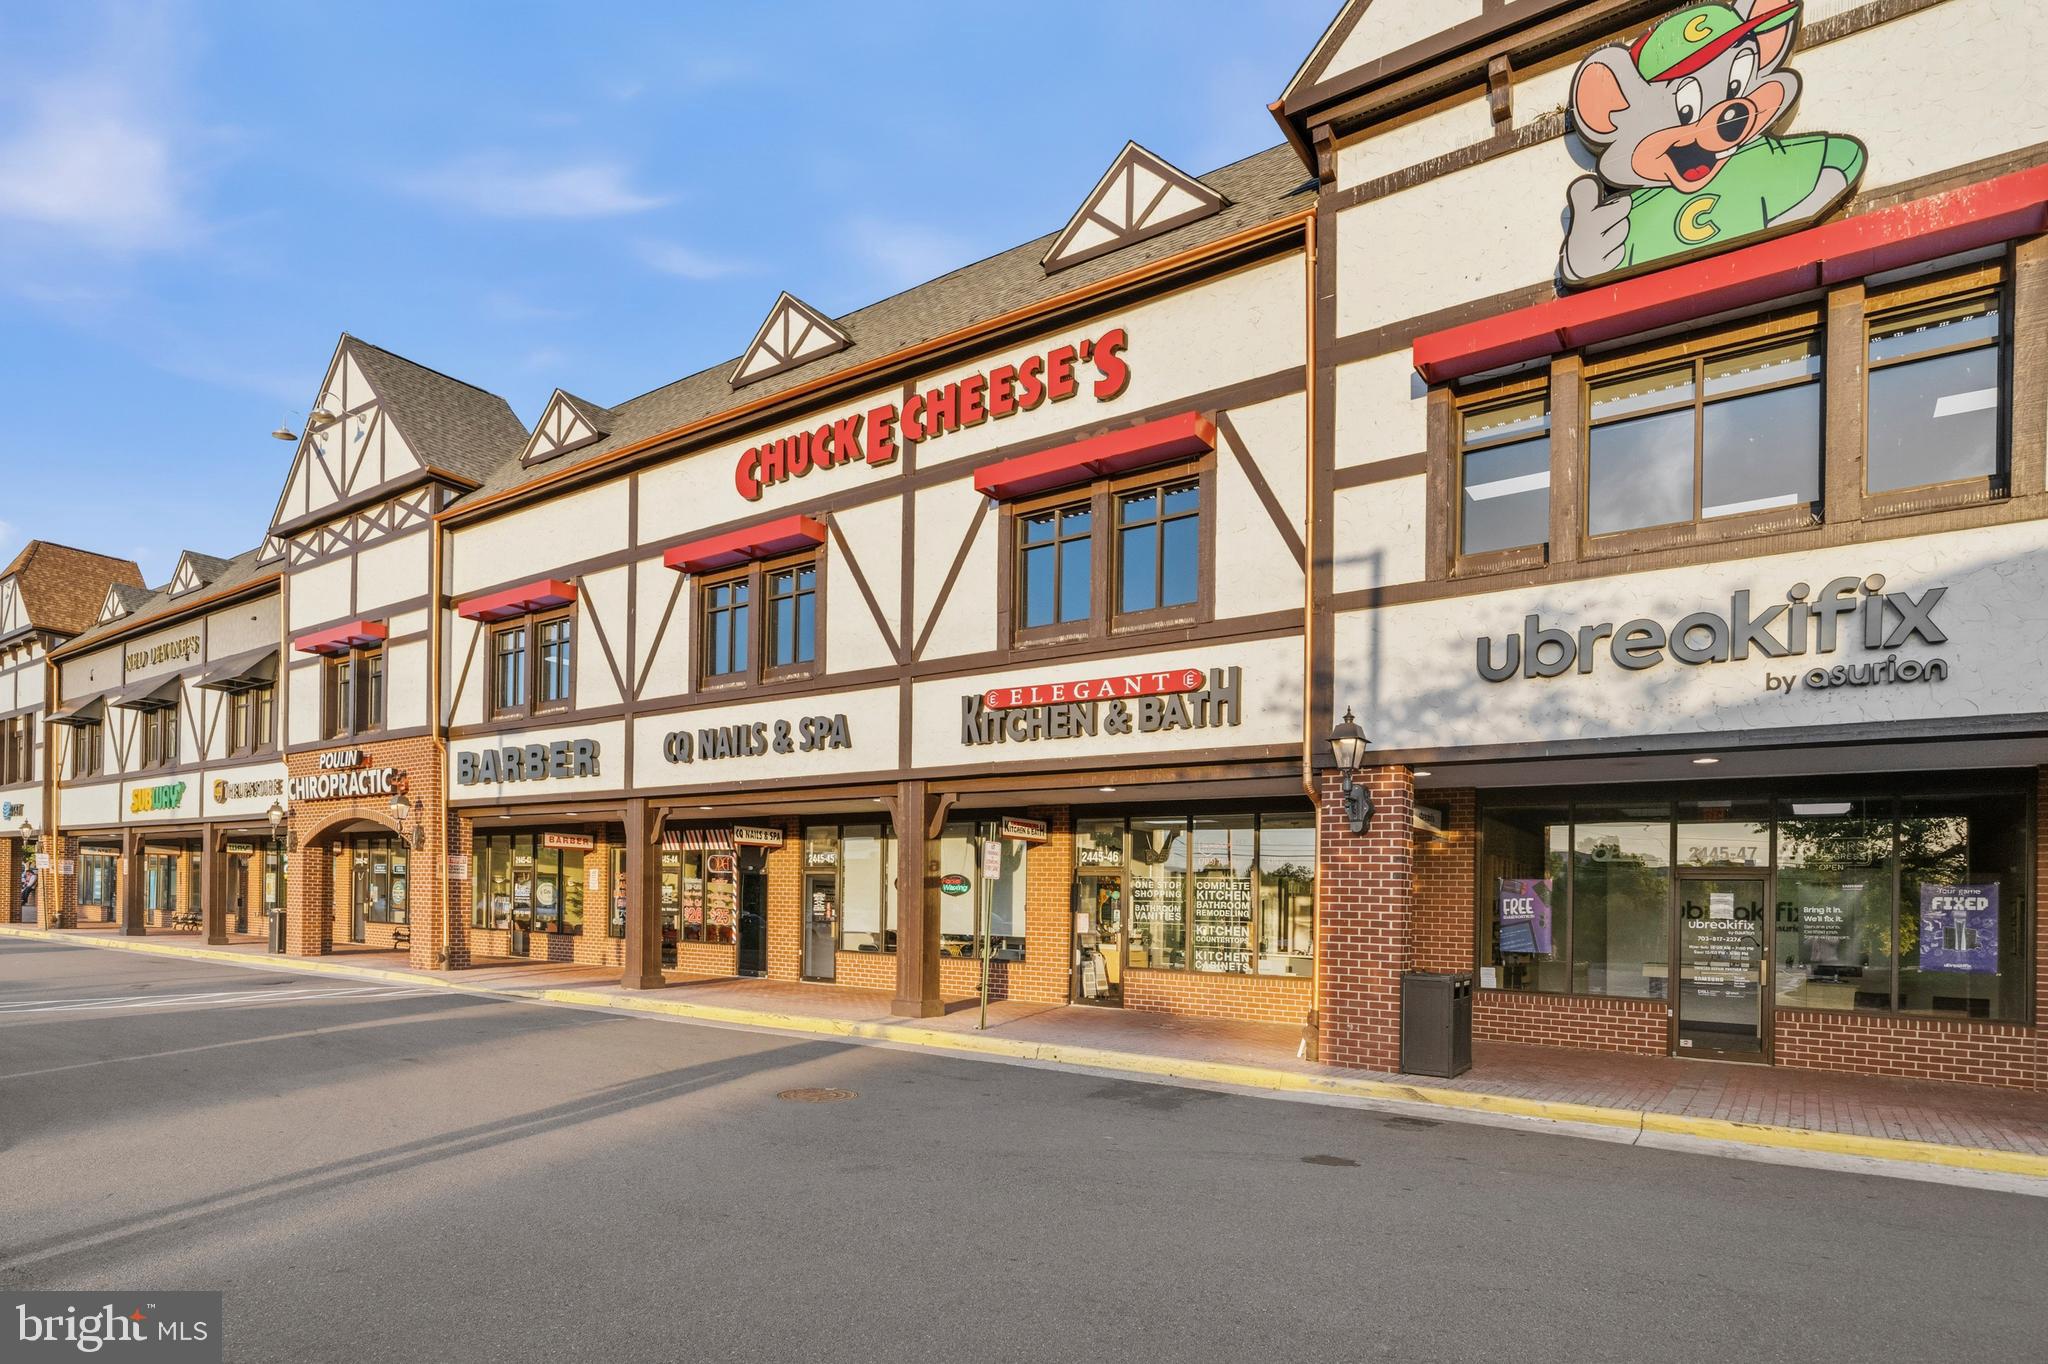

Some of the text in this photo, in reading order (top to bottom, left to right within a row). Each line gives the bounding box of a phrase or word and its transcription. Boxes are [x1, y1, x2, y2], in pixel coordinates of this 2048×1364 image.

[1477, 574, 1948, 682] ubreakifix
[1765, 655, 1948, 694] by asurion
[1010, 674, 1169, 704] ELEGANT
[961, 666, 1242, 745] KITCHEN & BATH
[663, 714, 852, 764] CQ NAILS & SPA
[320, 750, 358, 769] POULIN
[458, 739, 600, 785] BARBER
[288, 768, 393, 800] CHIROPRACTIC
[131, 782, 186, 813] SUBWAY
[549, 836, 589, 845] BARBER
[736, 829, 743, 837] CQ
[746, 830, 762, 839] NAILS
[770, 832, 780, 841] SPA
[1081, 851, 1119, 862] 2445-46
[1689, 846, 1758, 861] 2445-47
[1135, 881, 1182, 889] ONE STOP
[1196, 881, 1250, 890] COMPLETE
[1135, 890, 1182, 898] SHOPPING
[1196, 891, 1251, 901] KITCHEN
[1135, 905, 1181, 913] BATHROOM
[1196, 901, 1250, 909] BATHROOM
[1503, 897, 1535, 915] FREE
[1932, 897, 1988, 910] FIXED
[1135, 912, 1182, 921] VANITIES
[1196, 909, 1249, 918] REMODELING
[1688, 919, 1754, 930] ubreakifix
[1196, 925, 1250, 936] KITCHEN
[1196, 936, 1249, 945] COUNTERTOPS
[1195, 951, 1250, 962] KITCHEN
[1195, 961, 1249, 972] CABINETS
